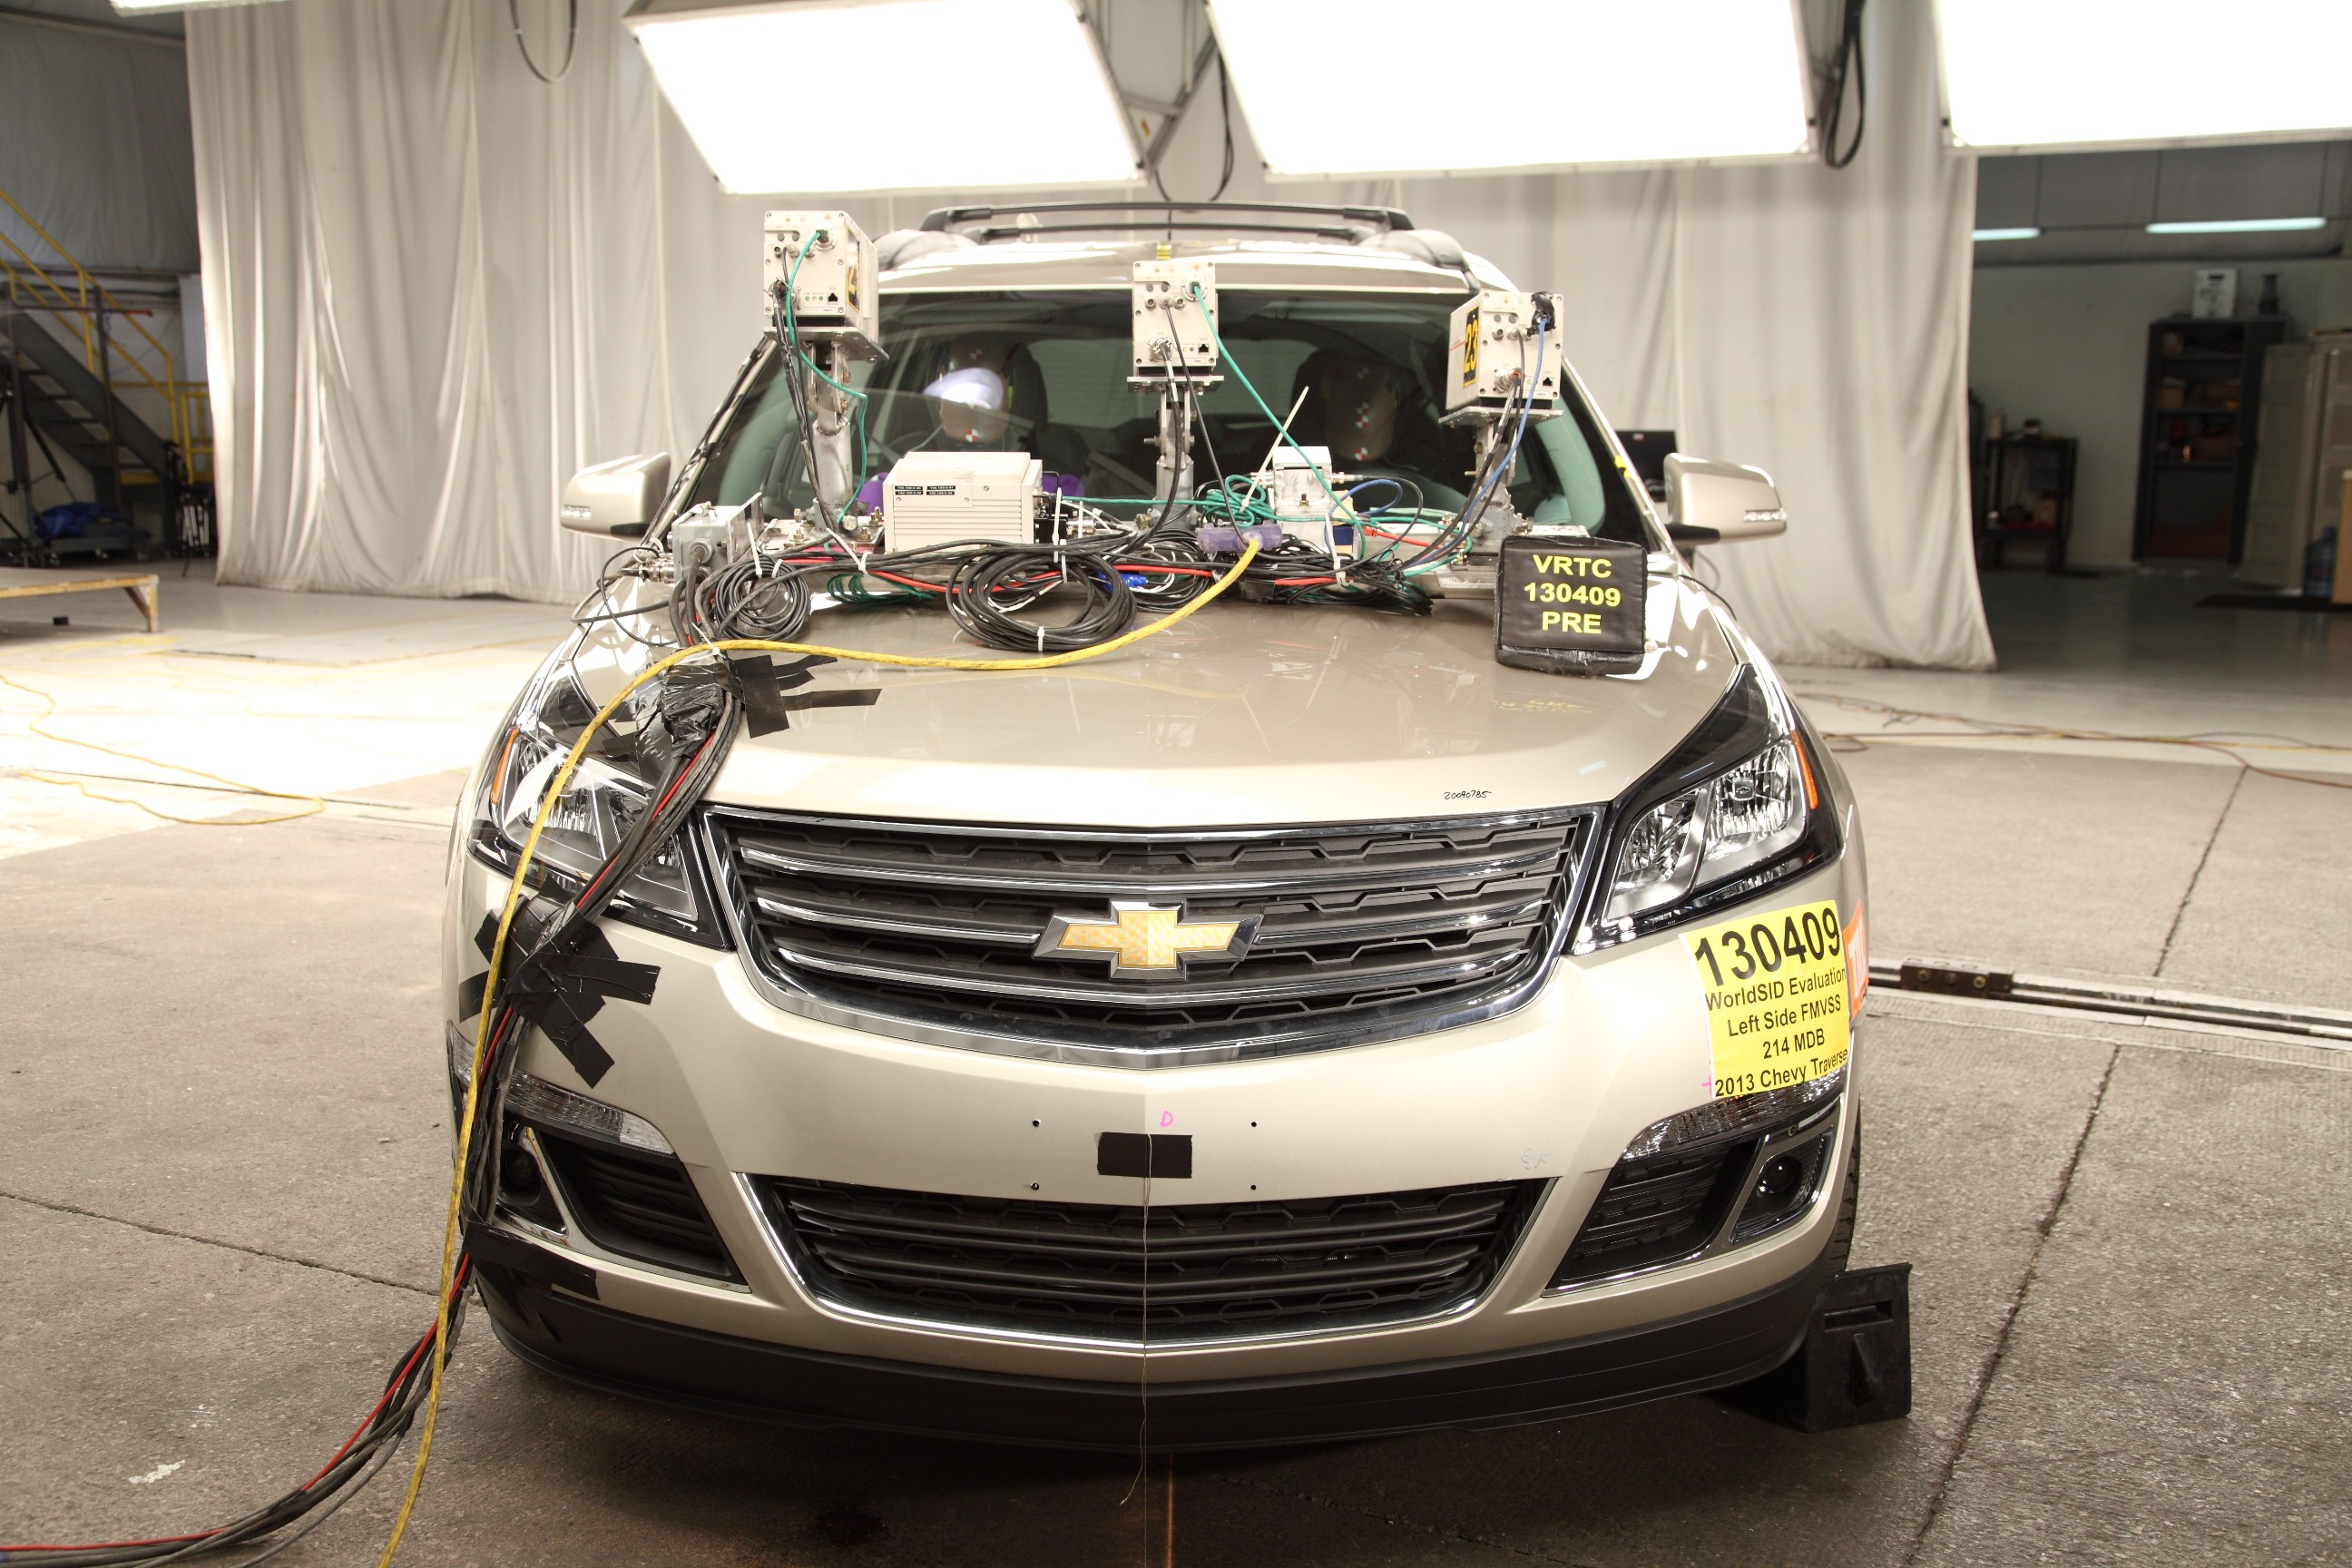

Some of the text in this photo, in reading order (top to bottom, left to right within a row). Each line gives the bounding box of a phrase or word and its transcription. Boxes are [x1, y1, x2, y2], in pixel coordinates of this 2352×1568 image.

[1464, 319, 1478, 374] 23
[1533, 554, 1612, 578] VRTC
[1524, 582, 1621, 607] 130409
[1542, 611, 1602, 634] PRE
[1695, 907, 1840, 986] 130409
[1705, 967, 1847, 1011] WorldSID Evaluation
[1728, 994, 1841, 1036] Left Side FMVSS
[1762, 1028, 1825, 1059] 214 MDB
[1715, 1048, 1847, 1097] 2013 Chevy Traverse
[1160, 1110, 1174, 1128] D
